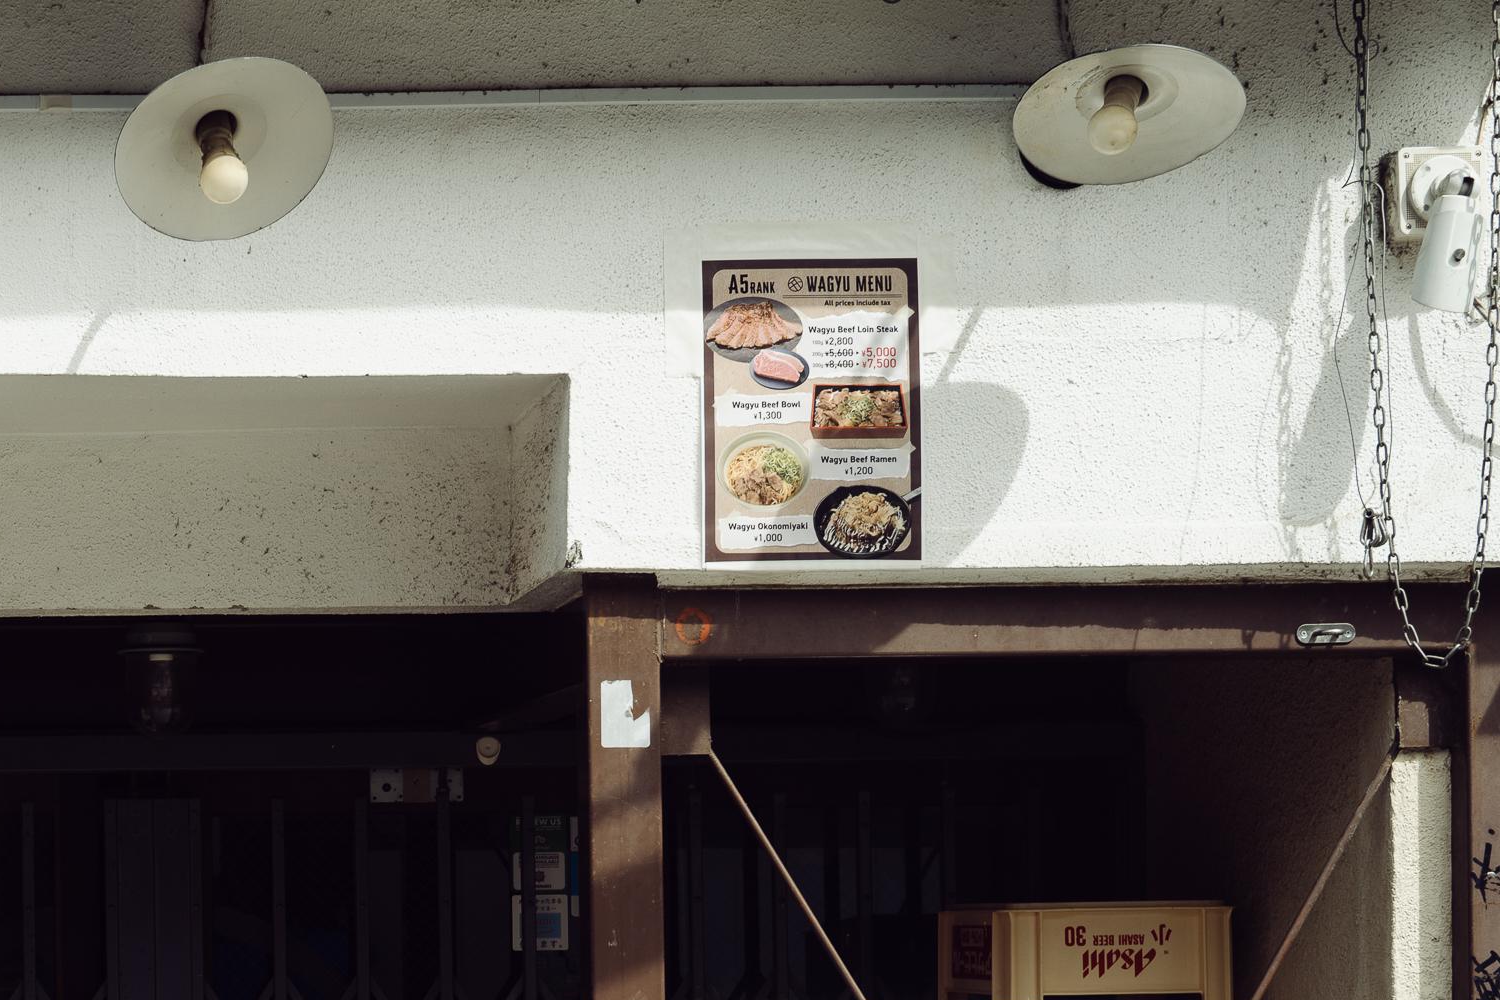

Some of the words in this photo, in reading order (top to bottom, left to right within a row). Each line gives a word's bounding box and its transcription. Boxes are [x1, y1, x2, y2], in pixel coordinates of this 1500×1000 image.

[806, 275, 850, 292] WAGYU
[855, 275, 892, 292] MENU
[835, 299, 855, 307] prices
[808, 326, 836, 335] Wagyu
[876, 325, 899, 333] Steak
[825, 336, 854, 346] ¥2,800
[861, 346, 897, 358] ¥5,000
[862, 358, 897, 370] ¥7,500
[732, 401, 759, 410] Wagyu
[754, 411, 782, 420] ¥1,300
[820, 456, 848, 465] Wagyu
[850, 455, 868, 463] Beef
[870, 455, 897, 463] Ramen
[844, 466, 873, 476] ¥1,200
[728, 523, 756, 532] Wagyu
[757, 522, 808, 531] Okonomiyaki
[754, 533, 783, 543] ¥1,000
[1064, 925, 1087, 947] 30
[1092, 934, 1115, 946] BEER
[1118, 934, 1145, 946] ASAHI
[1082, 948, 1157, 979] Asahi
